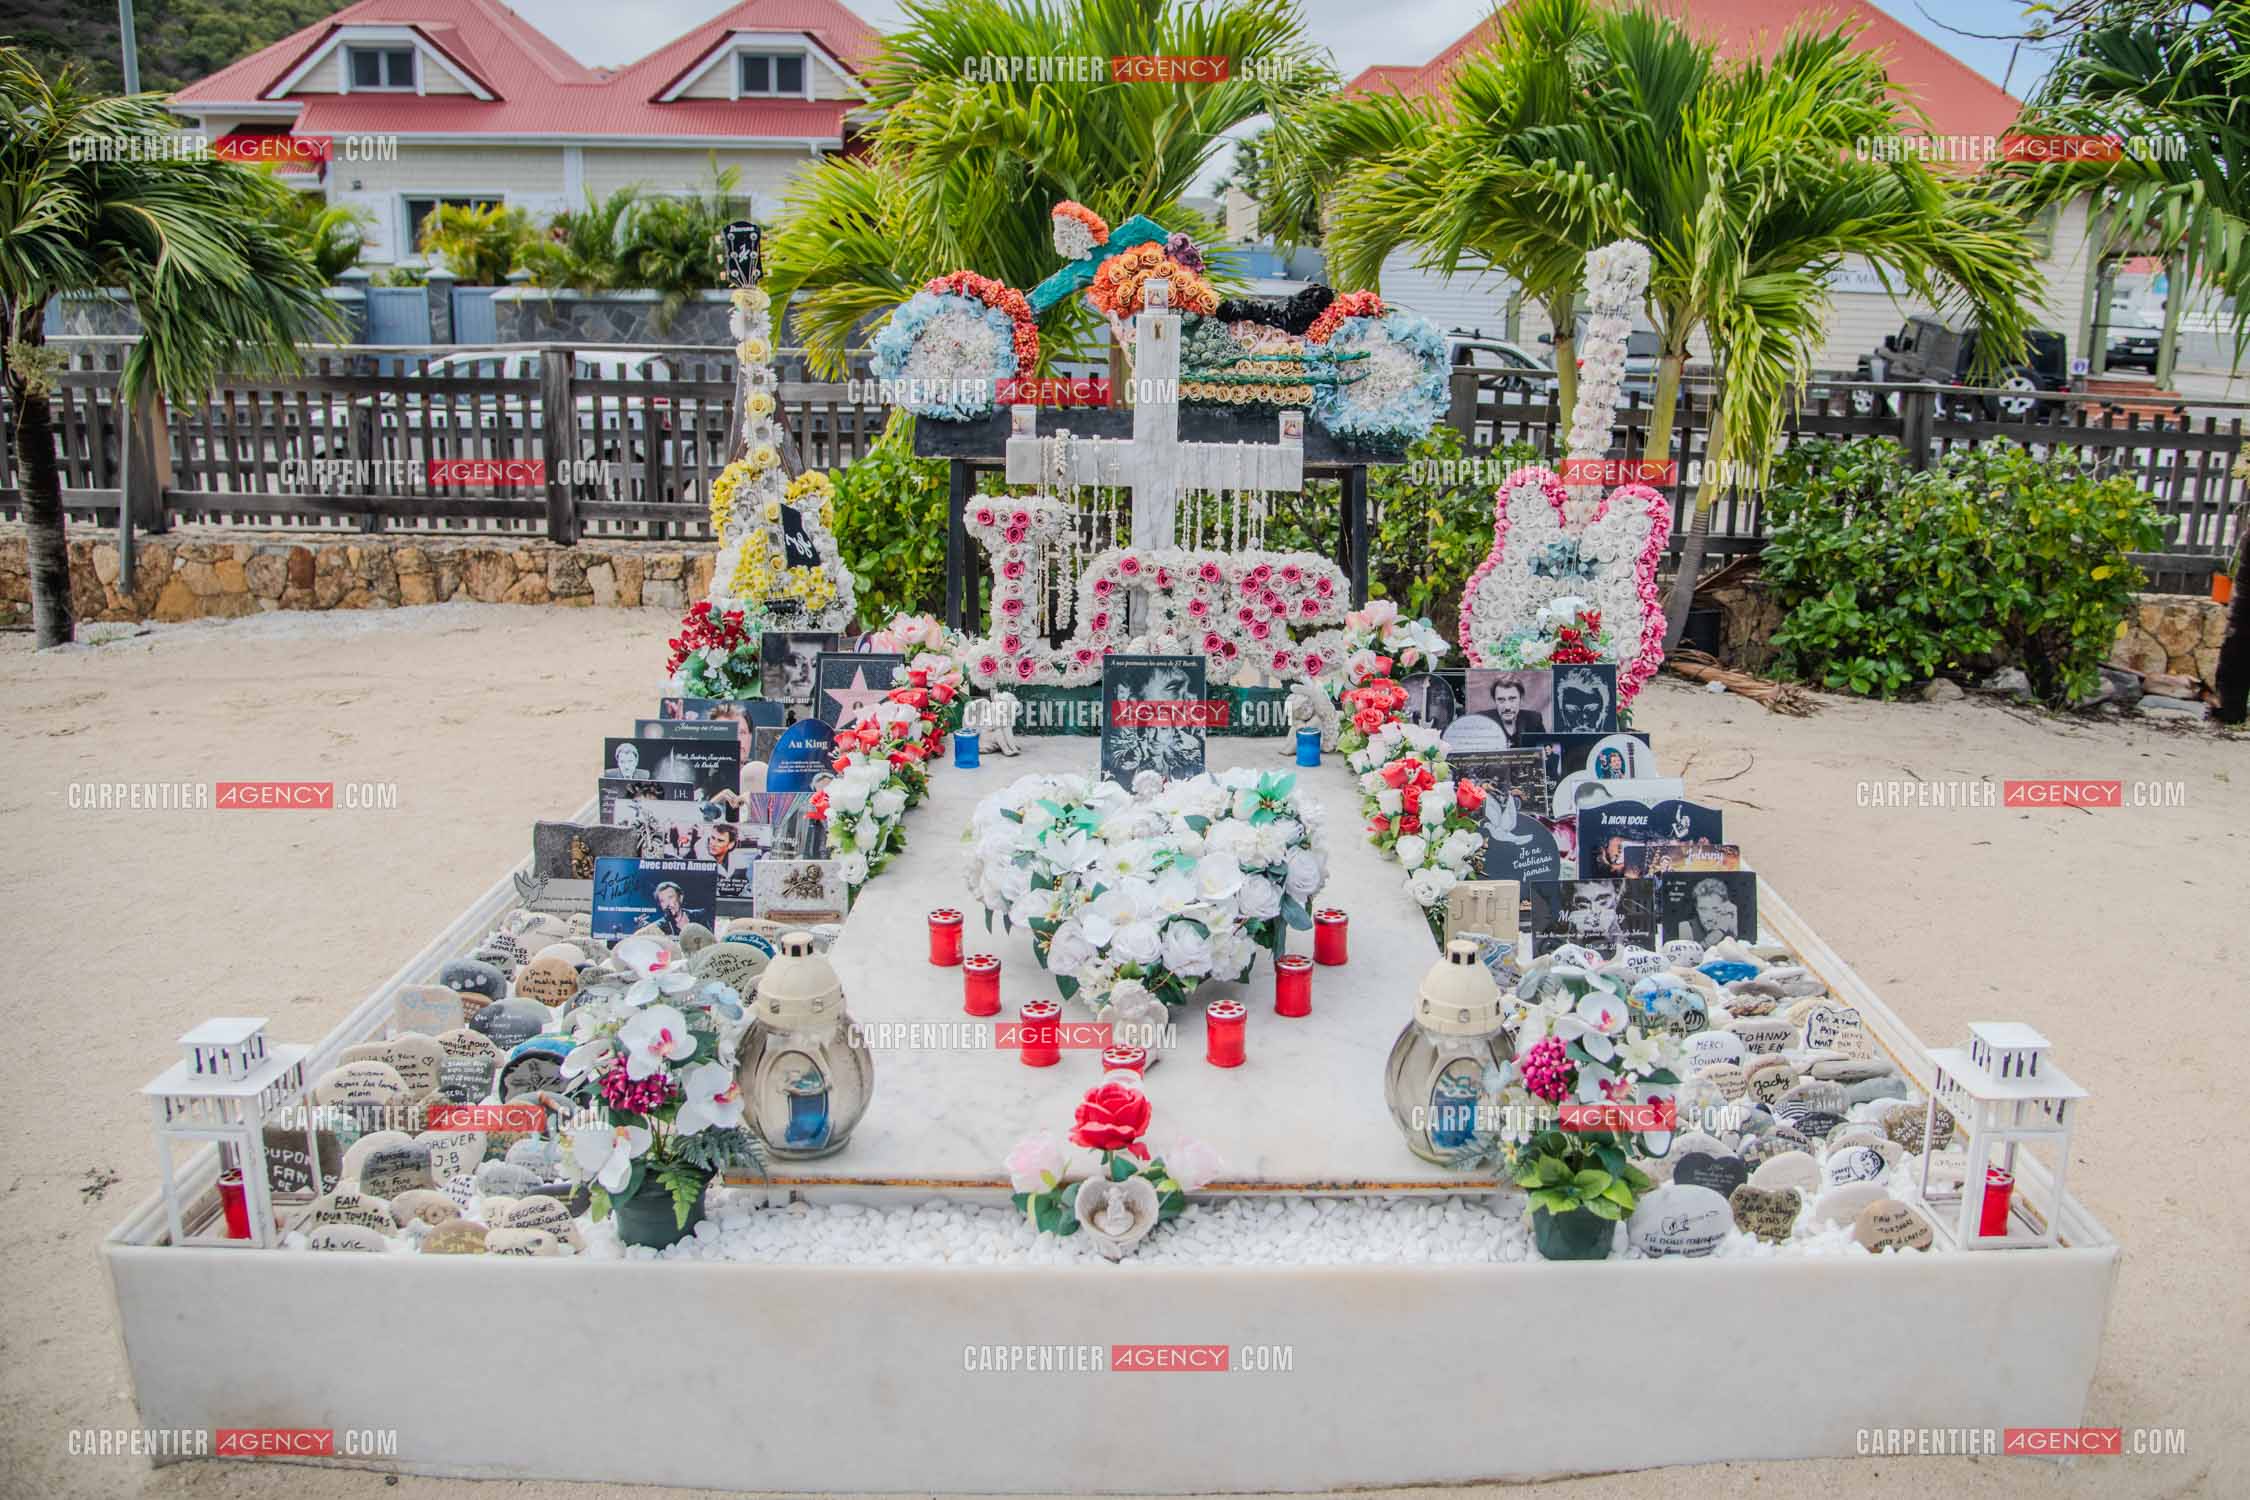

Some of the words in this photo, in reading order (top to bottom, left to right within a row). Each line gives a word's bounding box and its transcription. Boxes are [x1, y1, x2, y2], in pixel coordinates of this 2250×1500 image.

[788, 740, 802, 748] Au
[805, 740, 828, 750] King
[1608, 816, 1626, 825] MON
[1628, 816, 1649, 825] IDOLE
[640, 860, 660, 871] Avec
[662, 860, 686, 871] notre
[687, 861, 716, 872] Amour
[1753, 1073, 1790, 1095] Jacky
[272, 1165, 308, 1184] FAN
[335, 1195, 361, 1206] FAN
